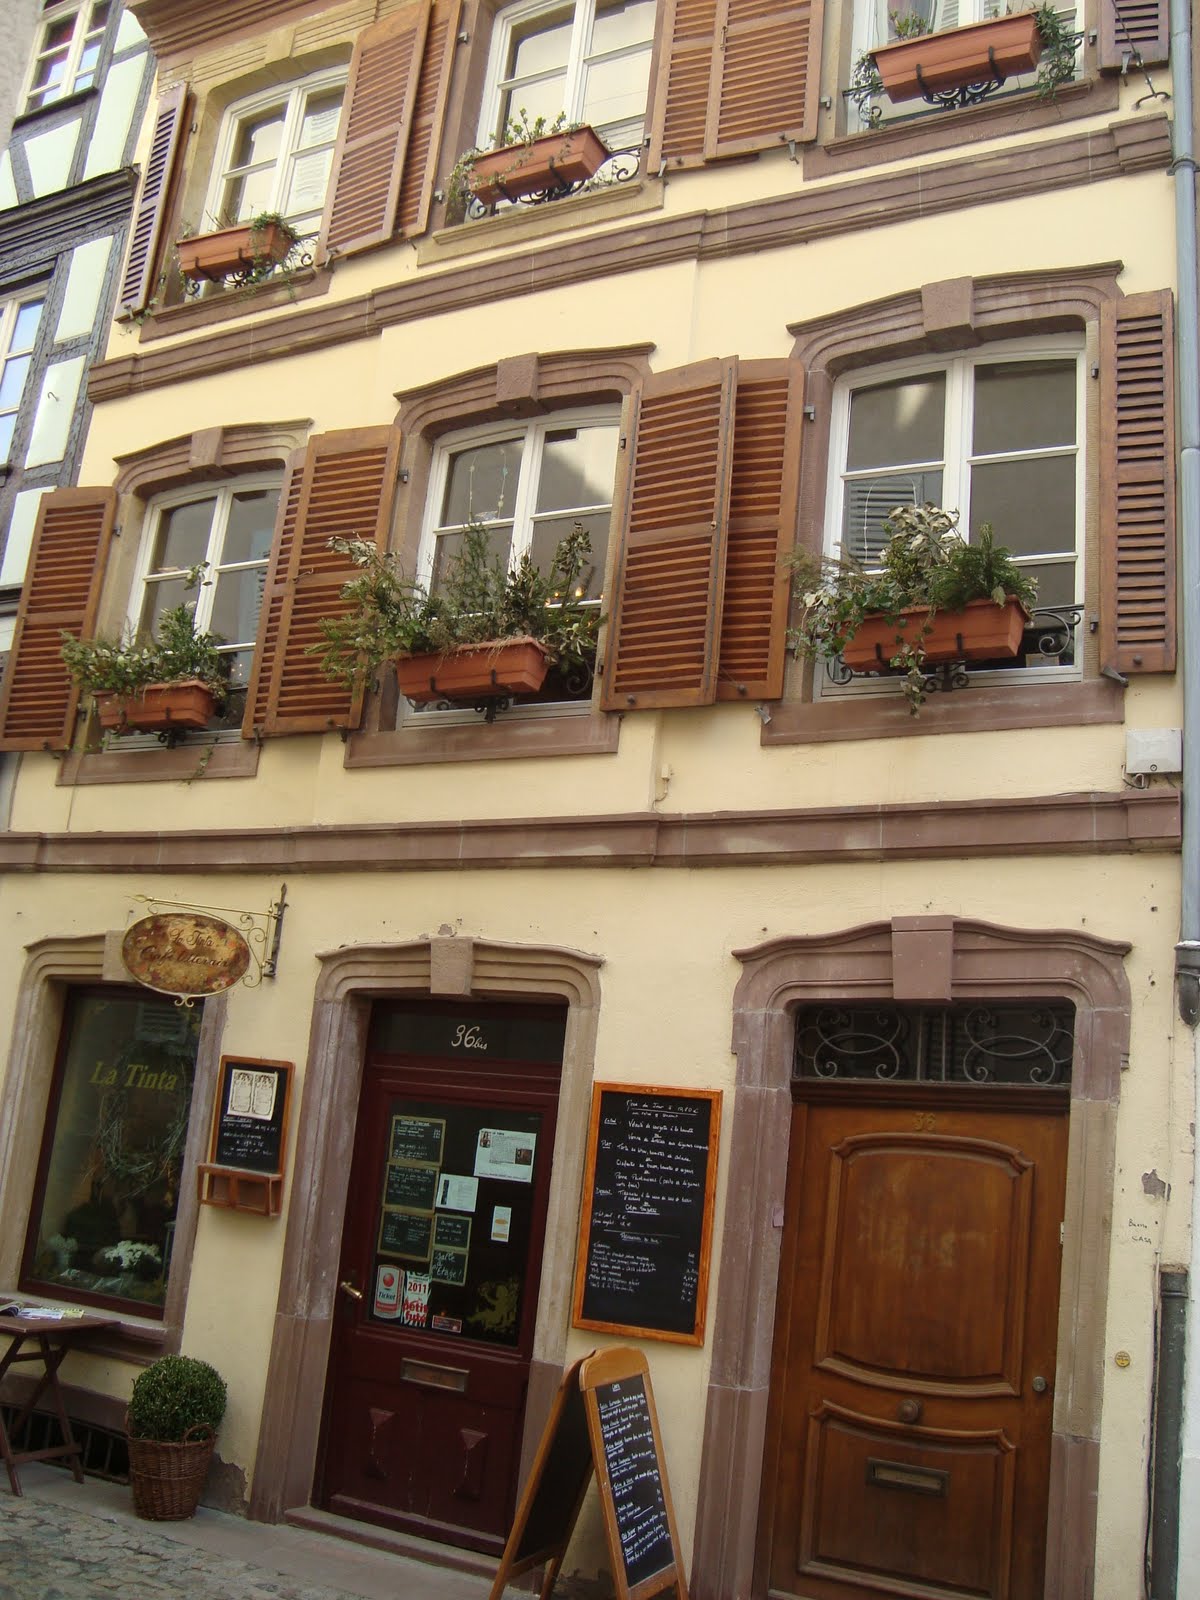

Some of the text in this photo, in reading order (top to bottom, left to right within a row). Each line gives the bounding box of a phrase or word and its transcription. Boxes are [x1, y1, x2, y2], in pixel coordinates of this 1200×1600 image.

[187, 930, 213, 946] Tinta
[88, 1061, 177, 1091] La Tinta
[408, 1281, 428, 1294] 2011
[379, 1291, 396, 1300] Ticket
